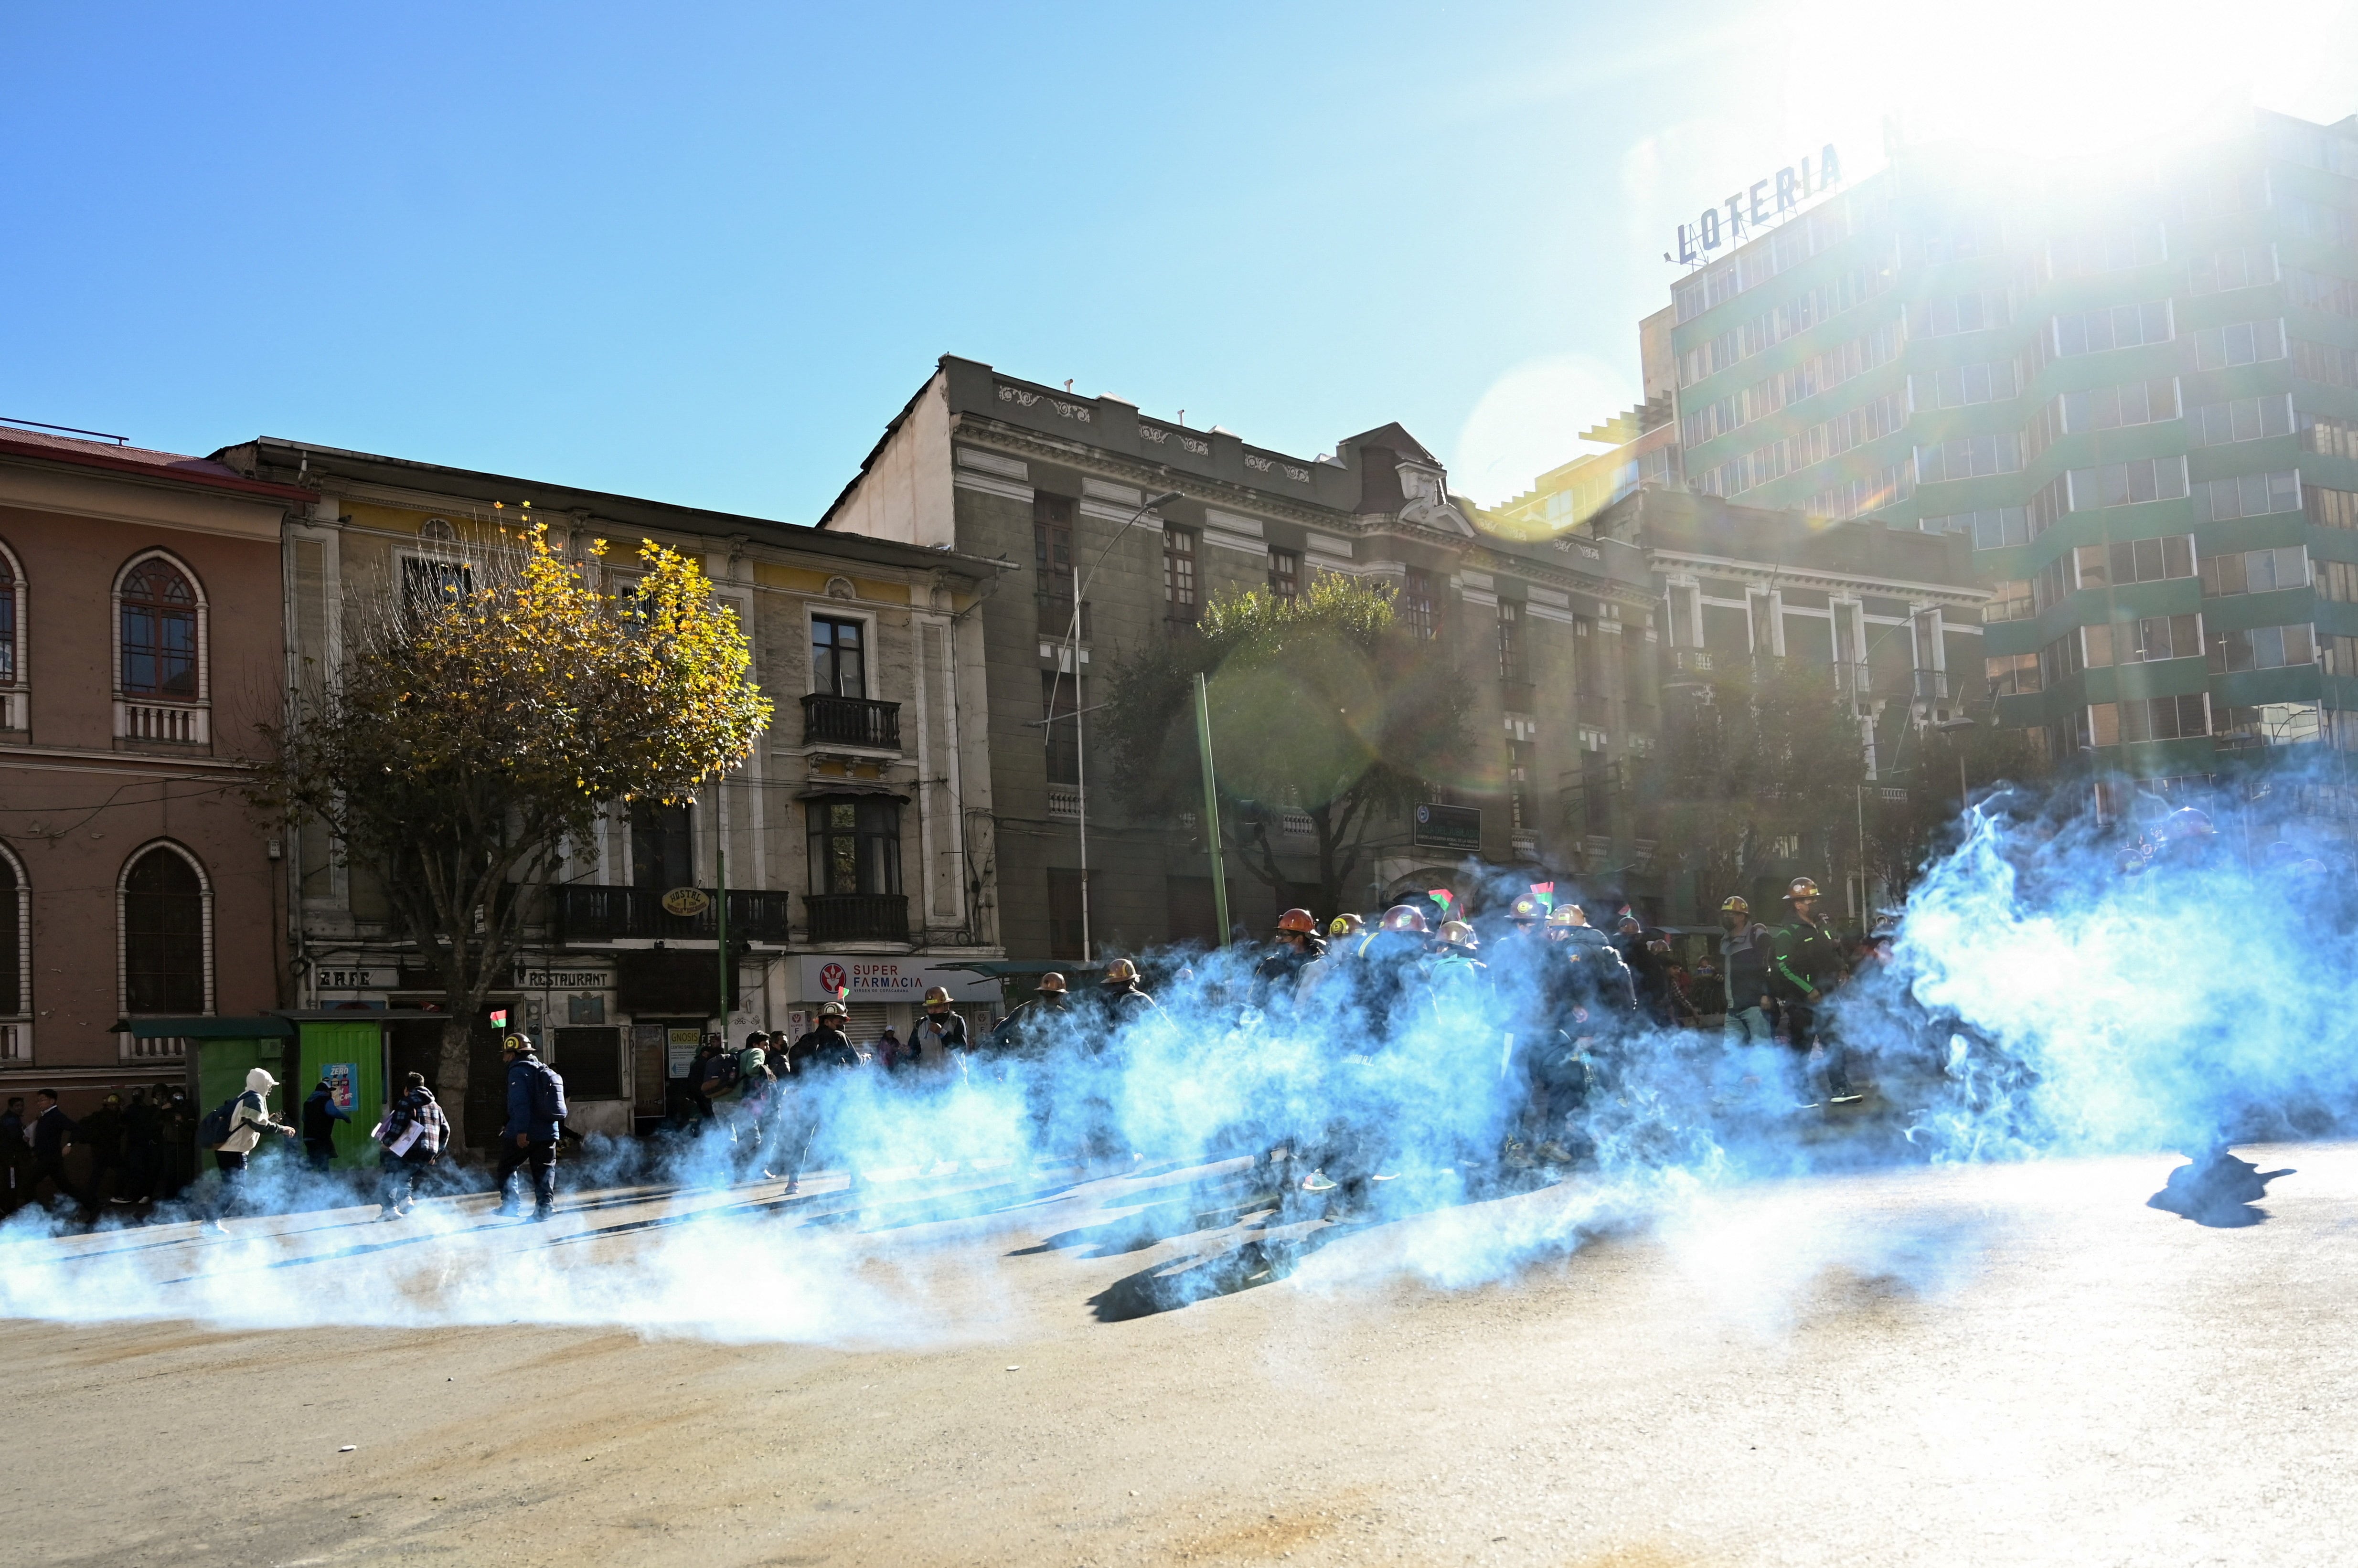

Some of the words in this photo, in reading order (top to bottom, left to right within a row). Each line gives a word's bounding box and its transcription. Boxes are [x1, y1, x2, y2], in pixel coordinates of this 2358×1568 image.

[1678, 143, 1842, 264] LOTERIA
[1435, 826, 1447, 835] DEL
[1448, 827, 1479, 838] JUBILADO
[670, 890, 701, 903] HOSTAL
[854, 964, 898, 975] SUPER
[320, 971, 370, 986] CAFE
[529, 972, 607, 986] RESTAURANT
[854, 977, 923, 987] FARMACIA
[672, 1033, 698, 1042] GNOSIS
[331, 1067, 349, 1075] ZERO
